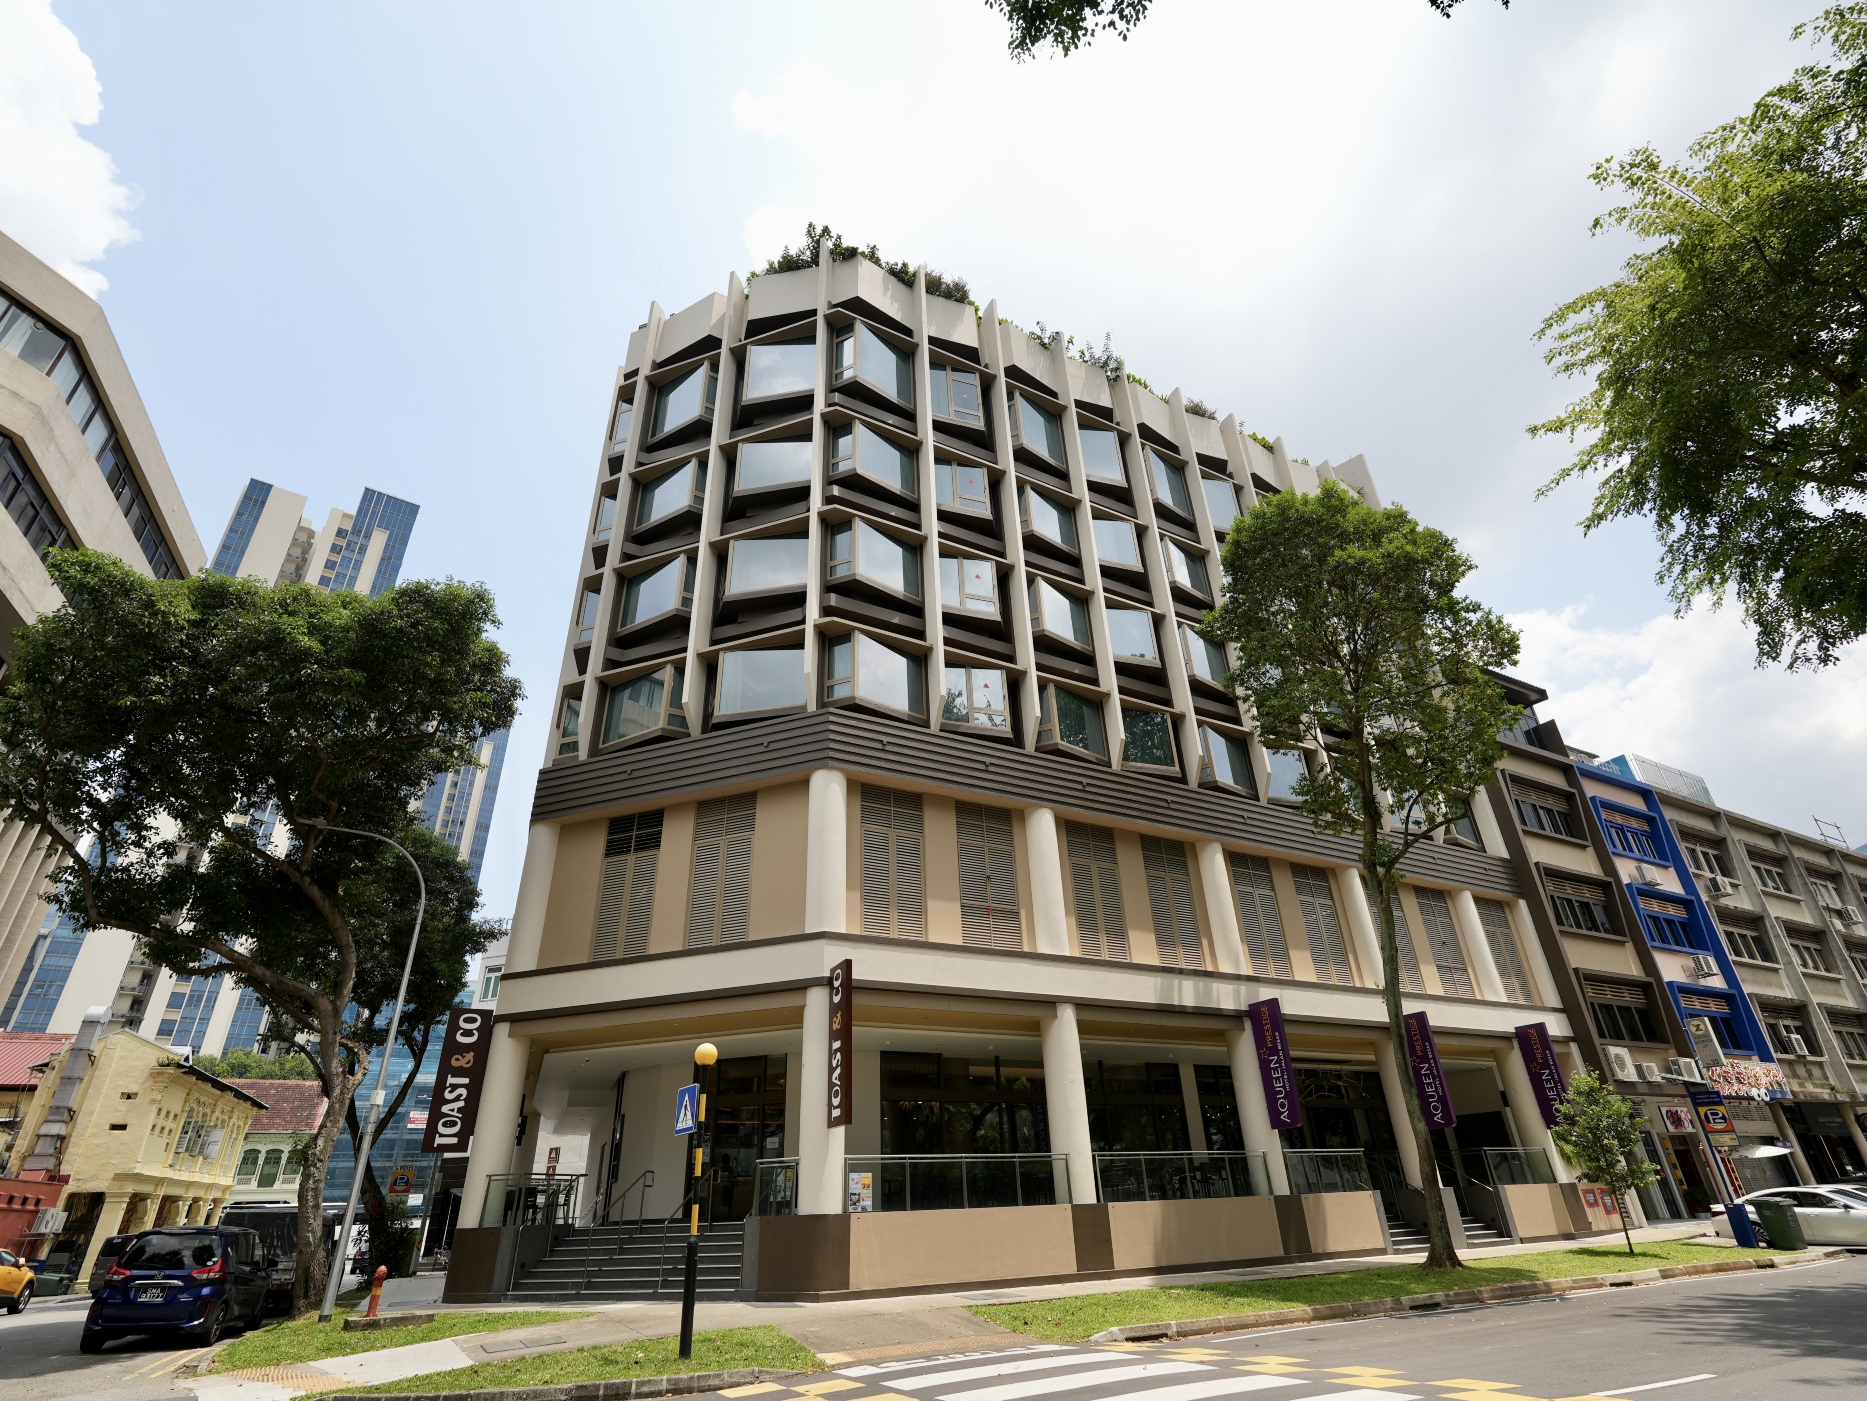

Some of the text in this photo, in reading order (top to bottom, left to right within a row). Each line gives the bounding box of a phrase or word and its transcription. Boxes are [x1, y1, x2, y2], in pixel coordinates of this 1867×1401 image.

[832, 968, 842, 1121] TOAST & CO
[1260, 1005, 1273, 1046] PRESTIGE
[1408, 1018, 1423, 1056] PRESTIGE
[1527, 1028, 1543, 1063] PRESTIGE
[434, 1013, 481, 1147] TOAST & CO
[1269, 1056, 1290, 1122] AQUEEN
[1419, 1064, 1444, 1123] AQUEEN
